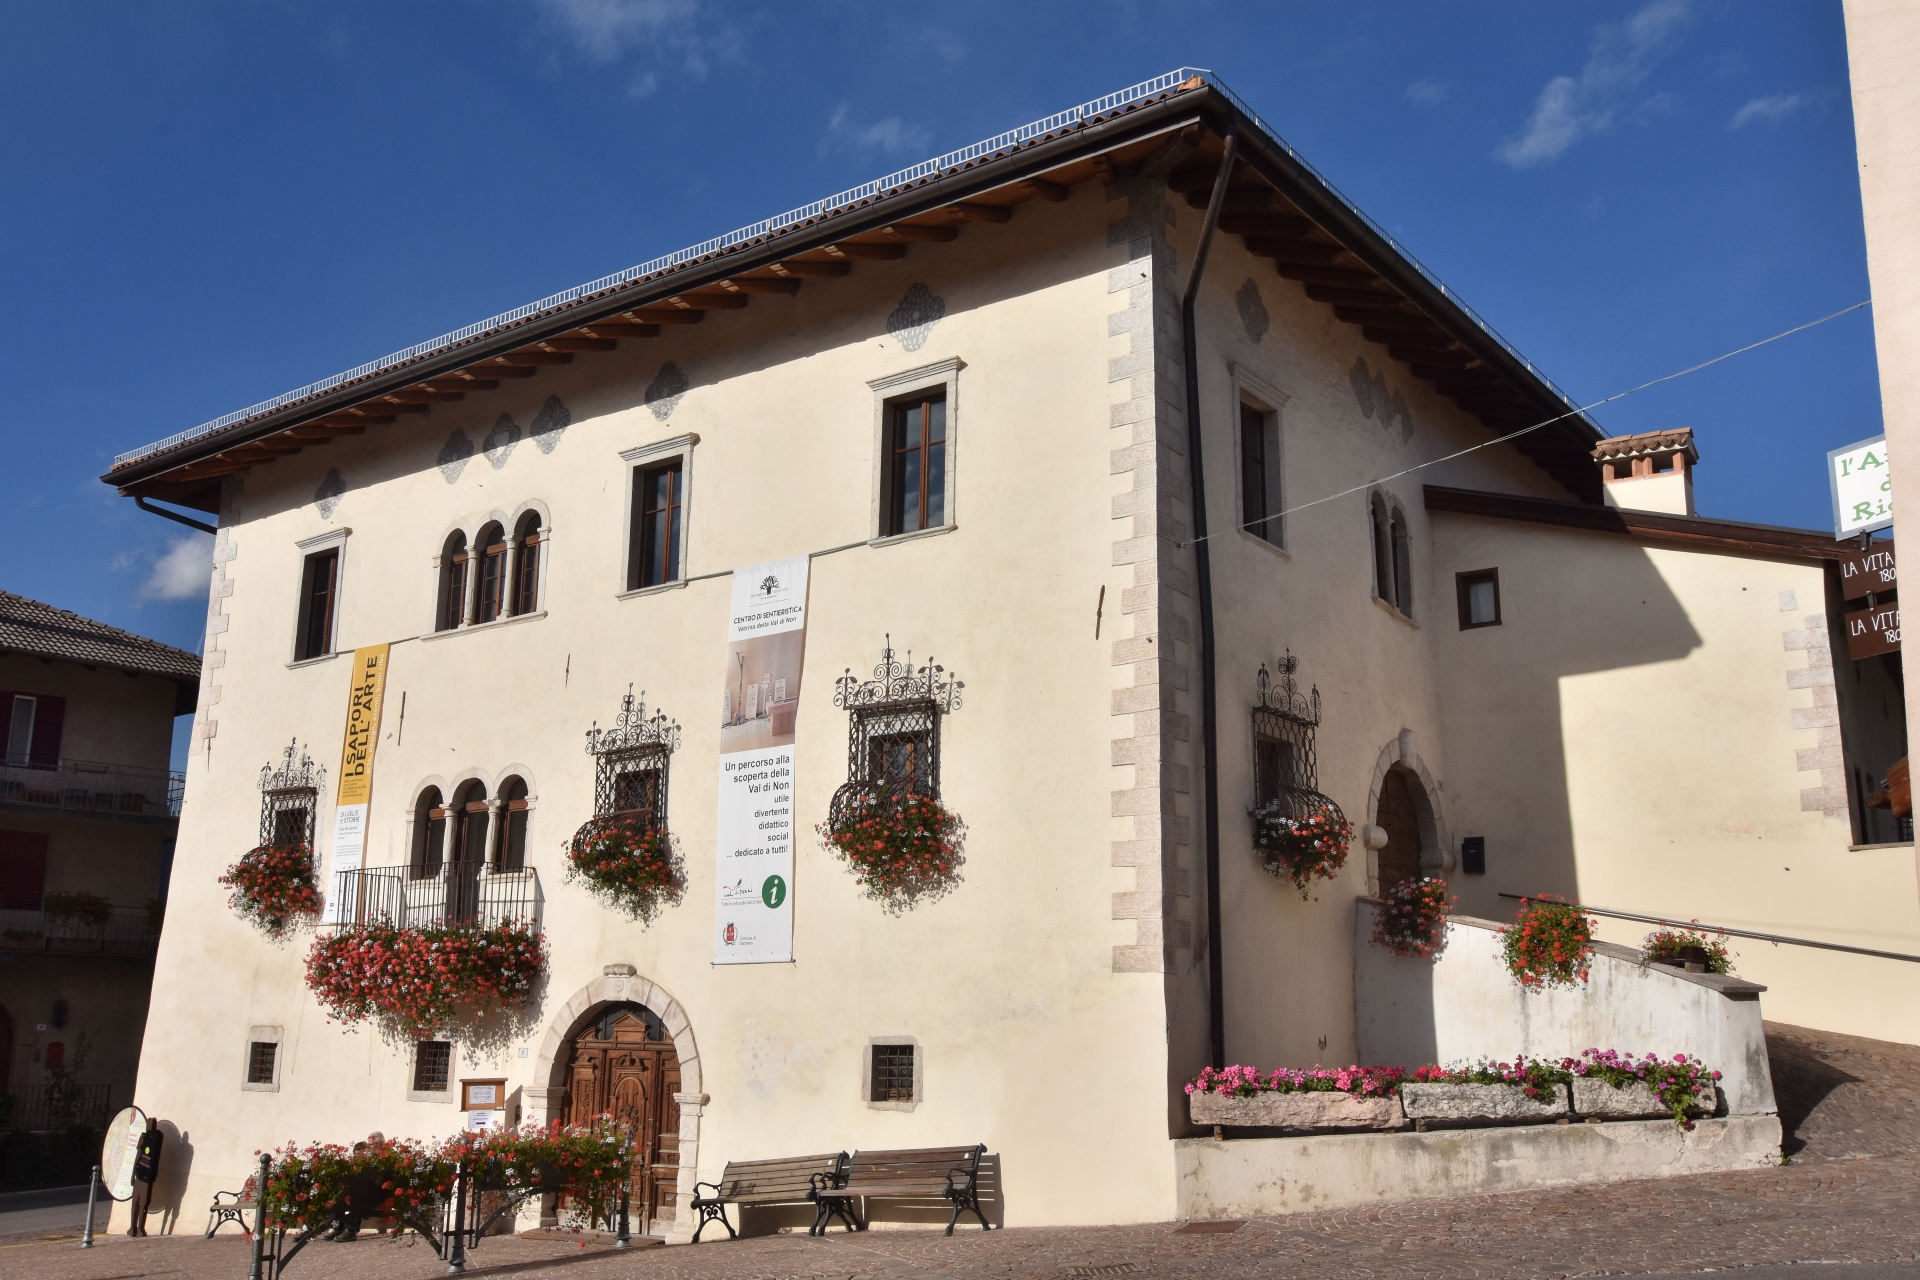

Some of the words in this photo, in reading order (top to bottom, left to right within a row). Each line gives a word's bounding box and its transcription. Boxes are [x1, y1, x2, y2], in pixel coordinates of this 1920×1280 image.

[1841, 451, 1888, 478] l'A
[1843, 561, 1858, 578] LA
[1862, 551, 1895, 573] VITA
[1879, 567, 1897, 583] 180
[733, 614, 756, 625] CENTRO
[762, 605, 803, 620] SENTIERISTICA
[737, 624, 756, 632] Vetrina
[756, 621, 769, 629] della
[1850, 619, 1867, 637] LA
[375, 672, 383, 693] buon
[372, 694, 380, 722] eventi,
[346, 686, 364, 765] SAPORI
[369, 723, 377, 753] design,
[725, 761, 736, 772] Un
[738, 757, 774, 773] percorso
[775, 754, 790, 765] alla
[733, 771, 769, 784] scoperta
[770, 767, 790, 779] della
[748, 783, 762, 795] Val
[763, 782, 772, 792] di
[773, 781, 790, 791] Non
[774, 794, 790, 804] utile
[754, 807, 789, 818] divertente
[758, 820, 789, 831] didattico
[767, 832, 789, 842] social
[734, 847, 765, 858] dedicato
[765, 847, 770, 855] a
[771, 845, 788, 855] tutti!
